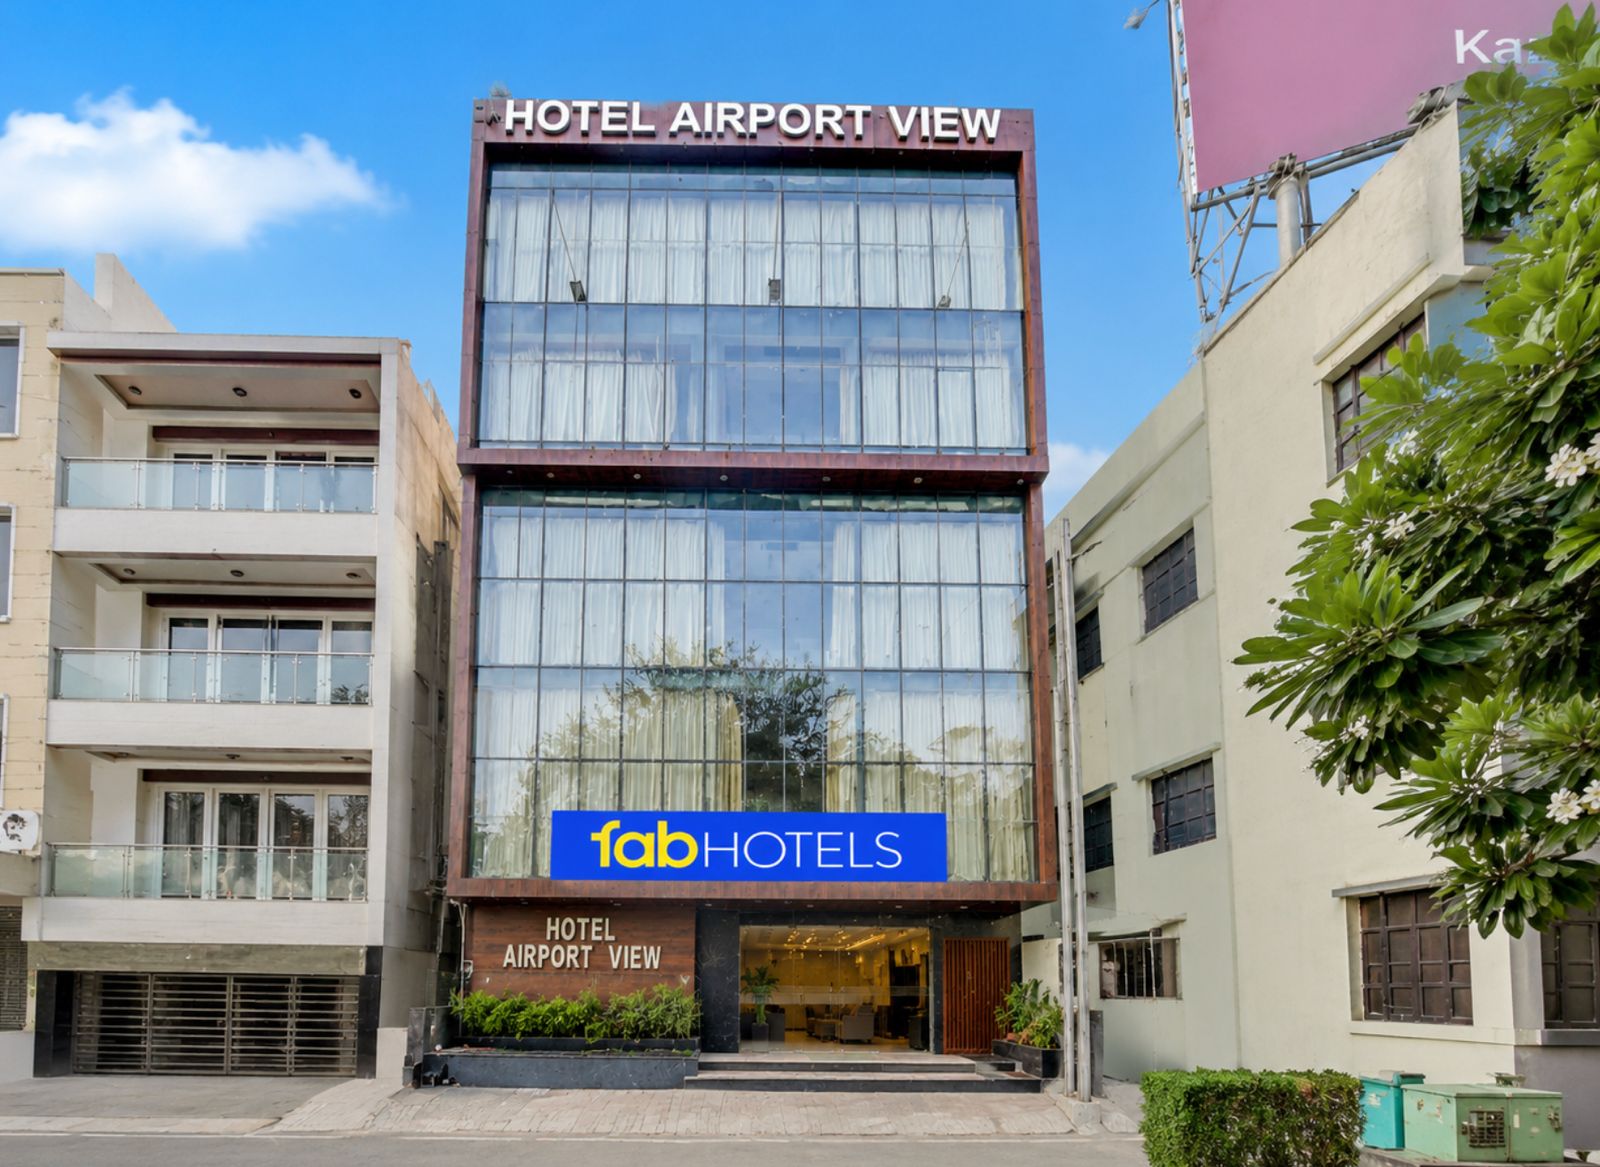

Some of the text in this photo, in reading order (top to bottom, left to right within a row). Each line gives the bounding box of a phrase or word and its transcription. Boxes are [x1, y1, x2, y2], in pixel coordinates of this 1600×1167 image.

[505, 99, 1001, 143] HOTEL AIRPORT VIEW
[545, 917, 616, 941] HOTEL
[503, 944, 662, 970] AIRPORT VIEW
